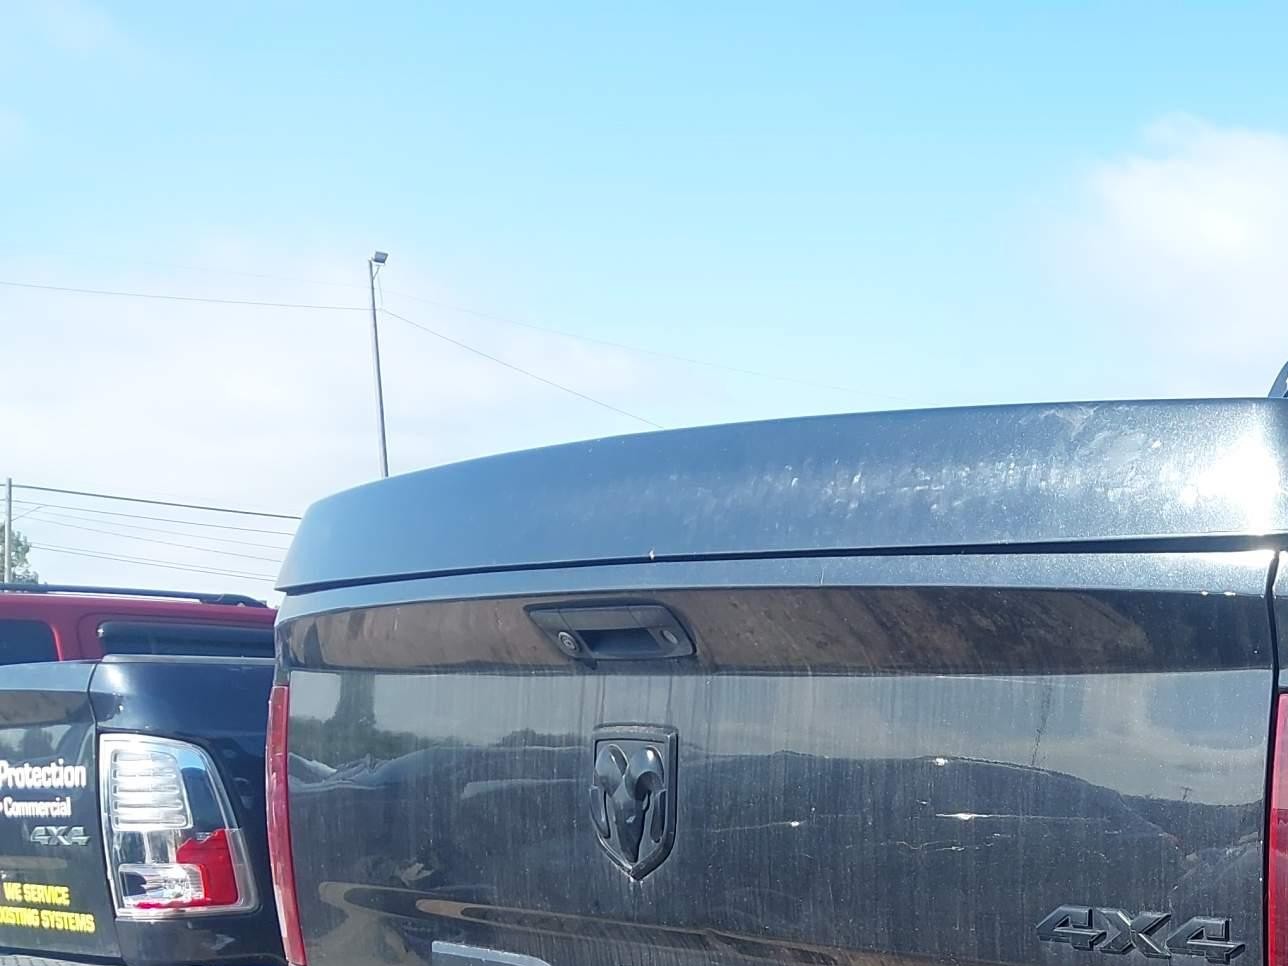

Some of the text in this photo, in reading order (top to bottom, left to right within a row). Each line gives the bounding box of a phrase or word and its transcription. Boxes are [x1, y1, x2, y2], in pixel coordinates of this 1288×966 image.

[0, 758, 87, 789] Protection
[4, 796, 72, 818] Commercial
[3, 882, 71, 907] WE SERVICE
[40, 909, 96, 934] SYSTEMS
